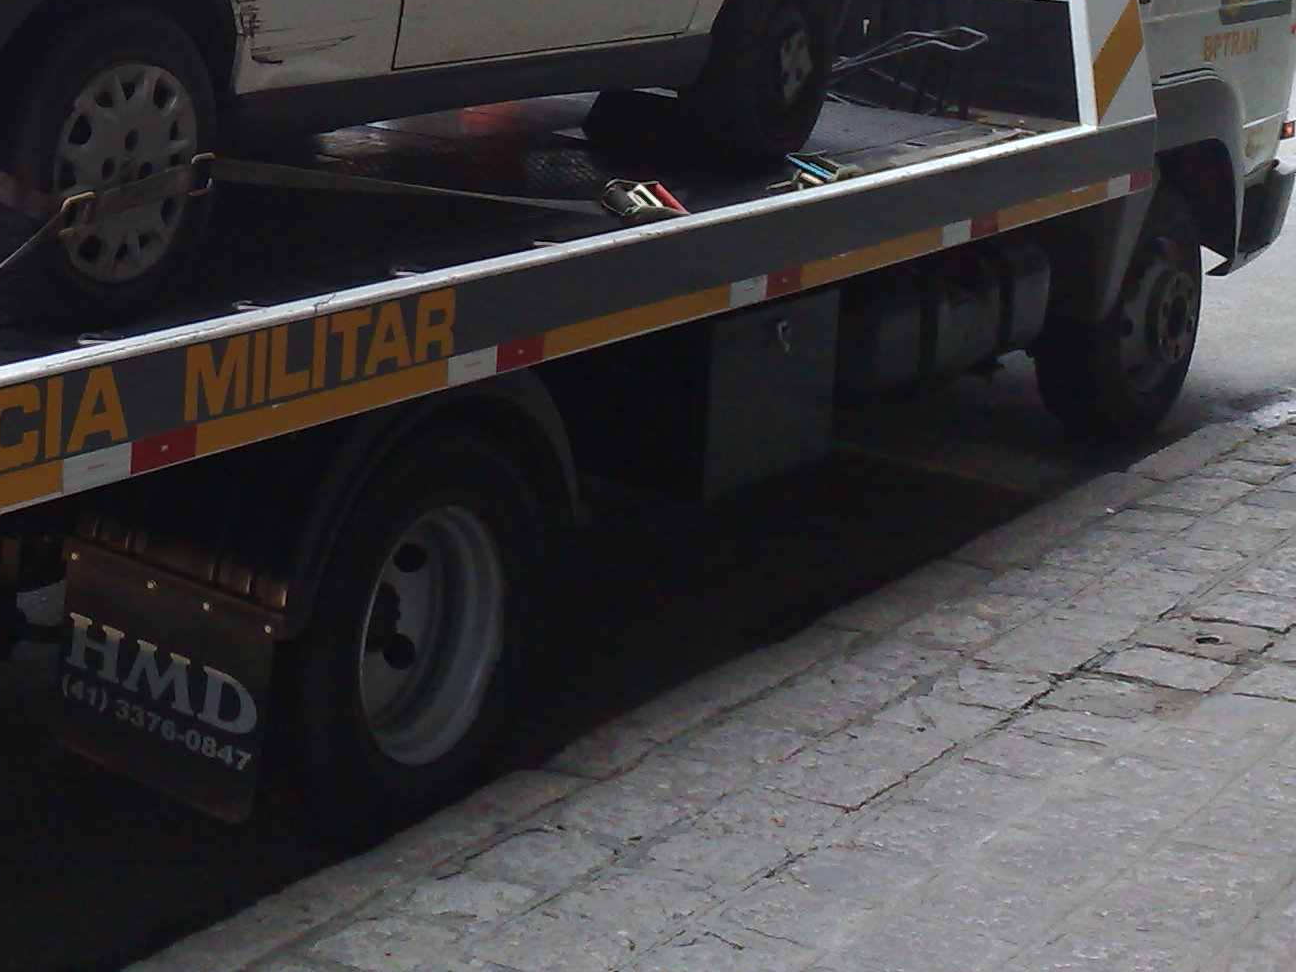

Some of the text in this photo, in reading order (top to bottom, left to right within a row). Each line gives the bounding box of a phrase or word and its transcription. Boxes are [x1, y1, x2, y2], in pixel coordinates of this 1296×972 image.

[184, 288, 456, 422] MILITAR
[62, 673, 107, 712] (41)
[66, 612, 258, 734] HMD
